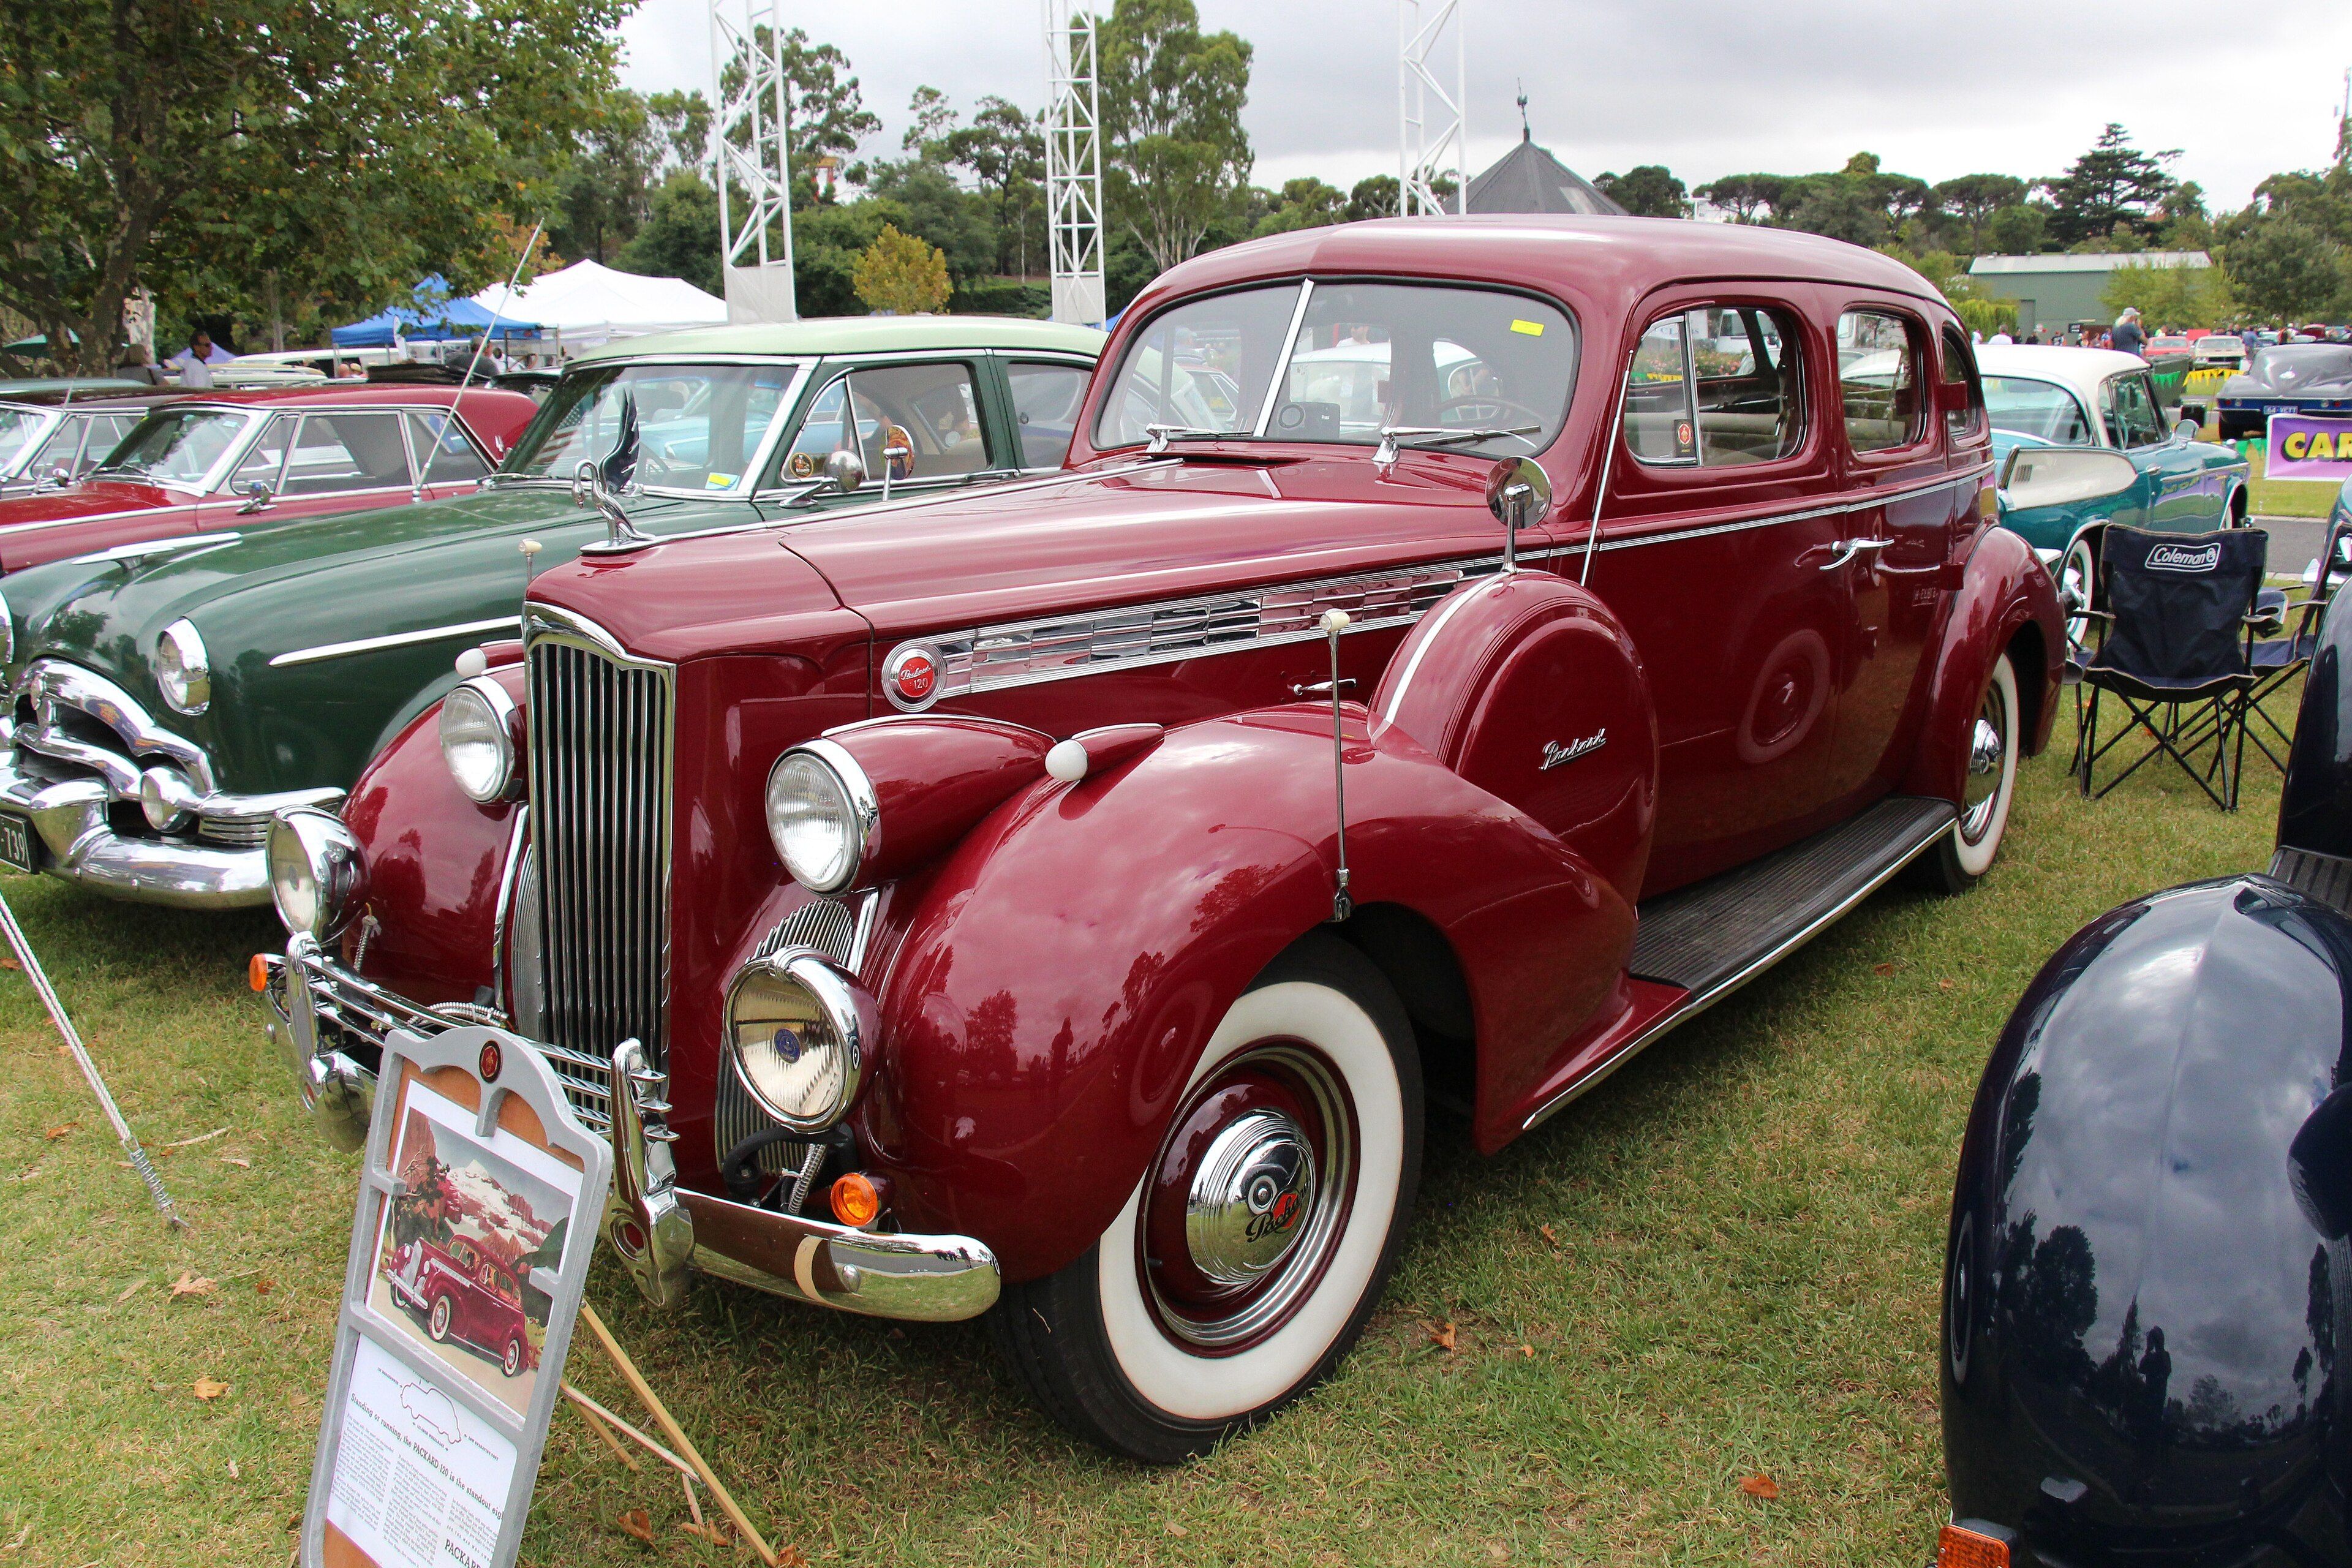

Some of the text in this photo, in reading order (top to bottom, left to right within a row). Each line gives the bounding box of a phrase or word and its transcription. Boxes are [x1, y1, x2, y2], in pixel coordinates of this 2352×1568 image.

[2154, 547, 2206, 565] Coleman
[900, 665, 932, 680] Packard
[913, 678, 929, 690] 120
[1539, 728, 1607, 771] Packard
[350, 1393, 374, 1417] Standing
[380, 1419, 403, 1442] running,
[403, 1436, 412, 1448] the
[413, 1442, 439, 1469] PACKARD
[439, 1464, 449, 1477] 120
[450, 1471, 455, 1482] is
[456, 1477, 466, 1490] the
[466, 1487, 491, 1510] standout
[445, 1538, 481, 1568] PACKAR
